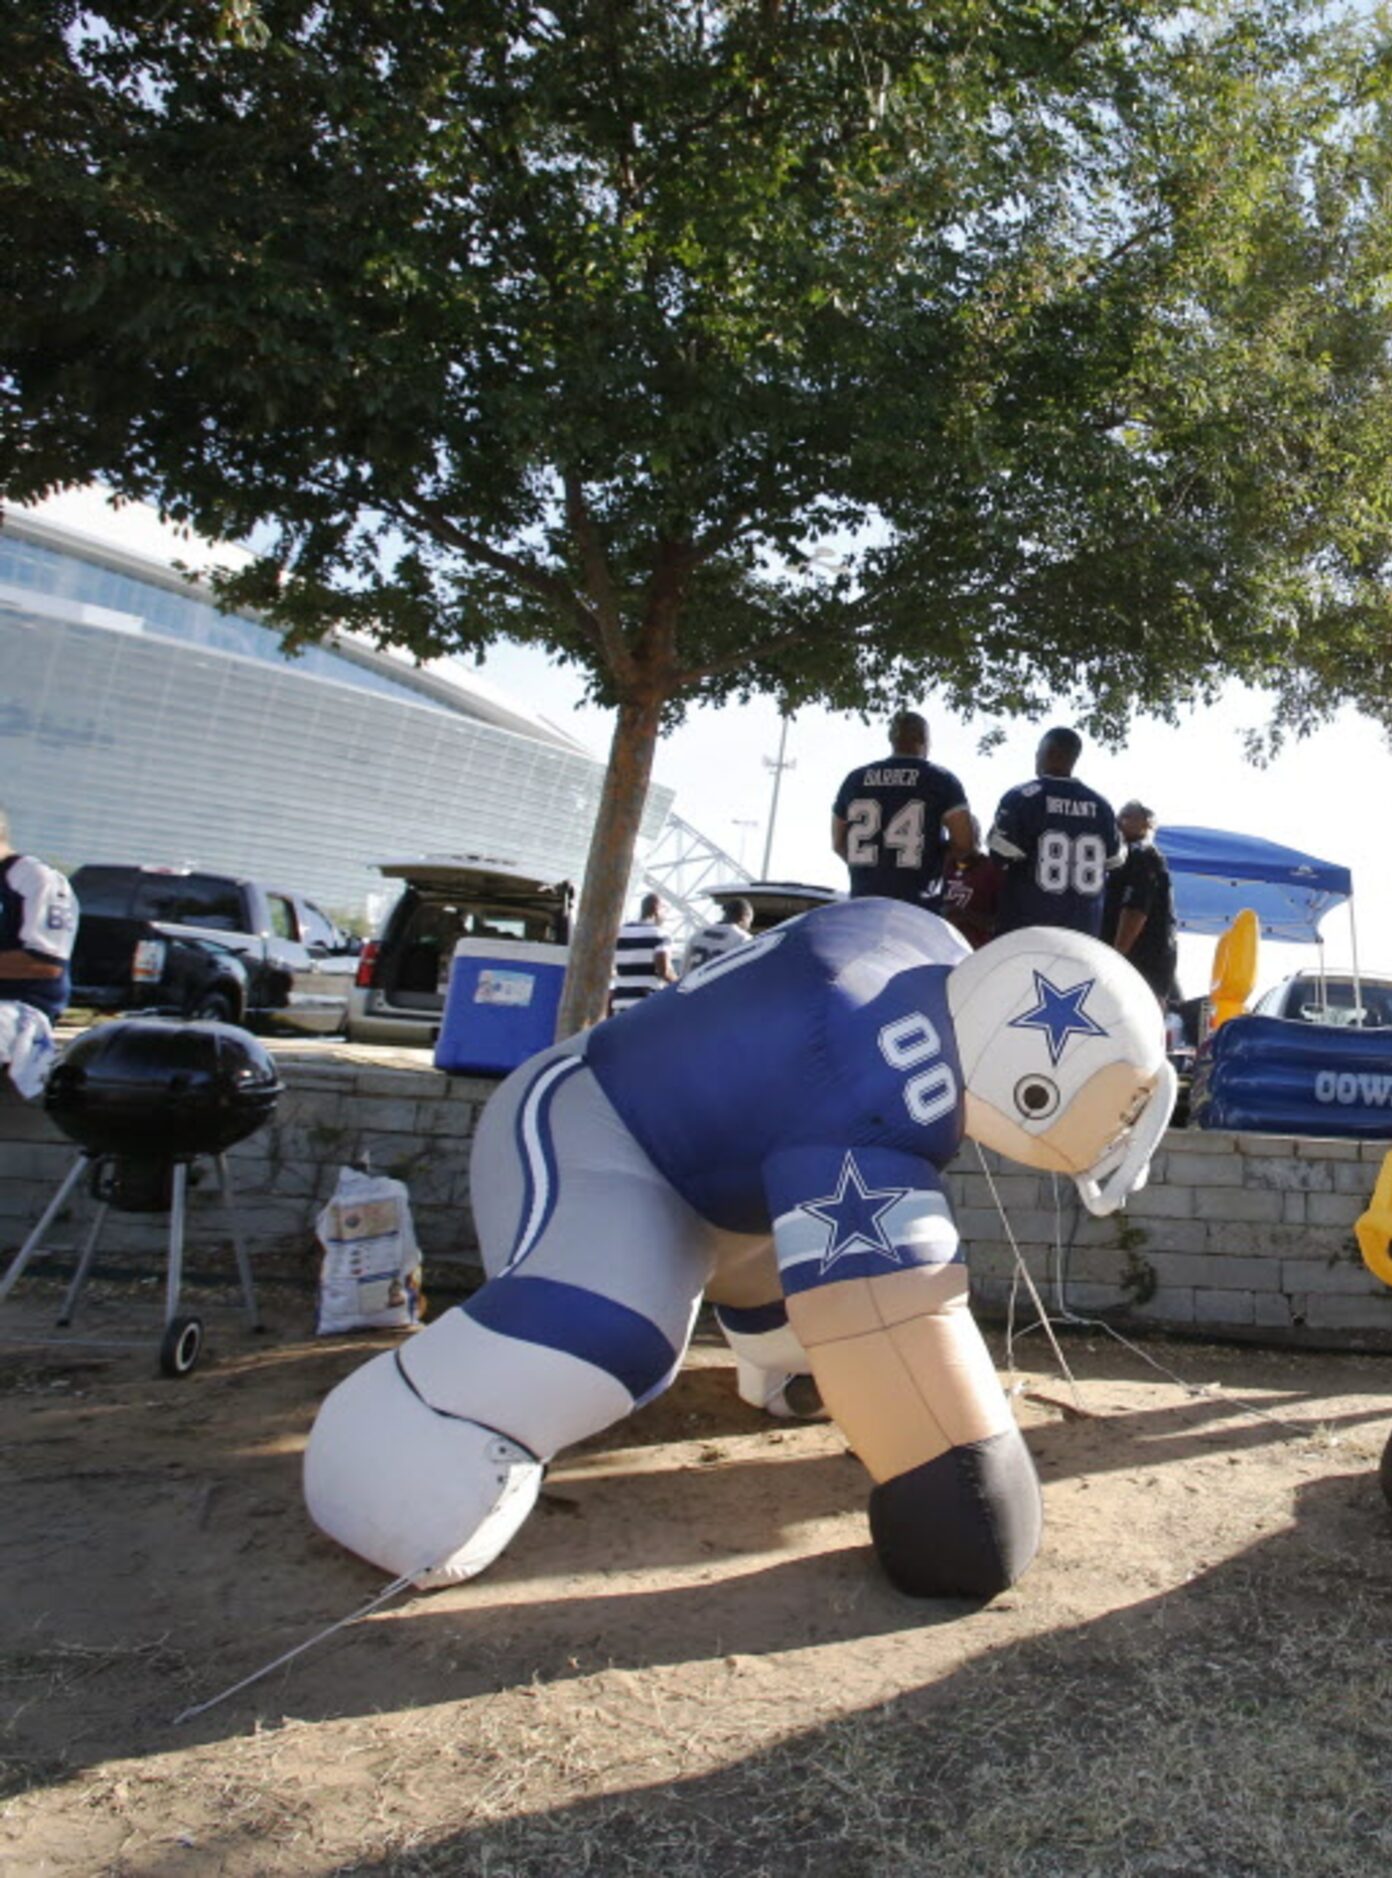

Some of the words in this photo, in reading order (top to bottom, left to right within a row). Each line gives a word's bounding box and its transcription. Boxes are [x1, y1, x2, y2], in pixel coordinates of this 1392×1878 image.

[846, 798, 925, 868] 24
[1046, 796, 1098, 819] BRYANT
[1036, 829, 1106, 896] 88
[877, 1010, 958, 1127] 00
